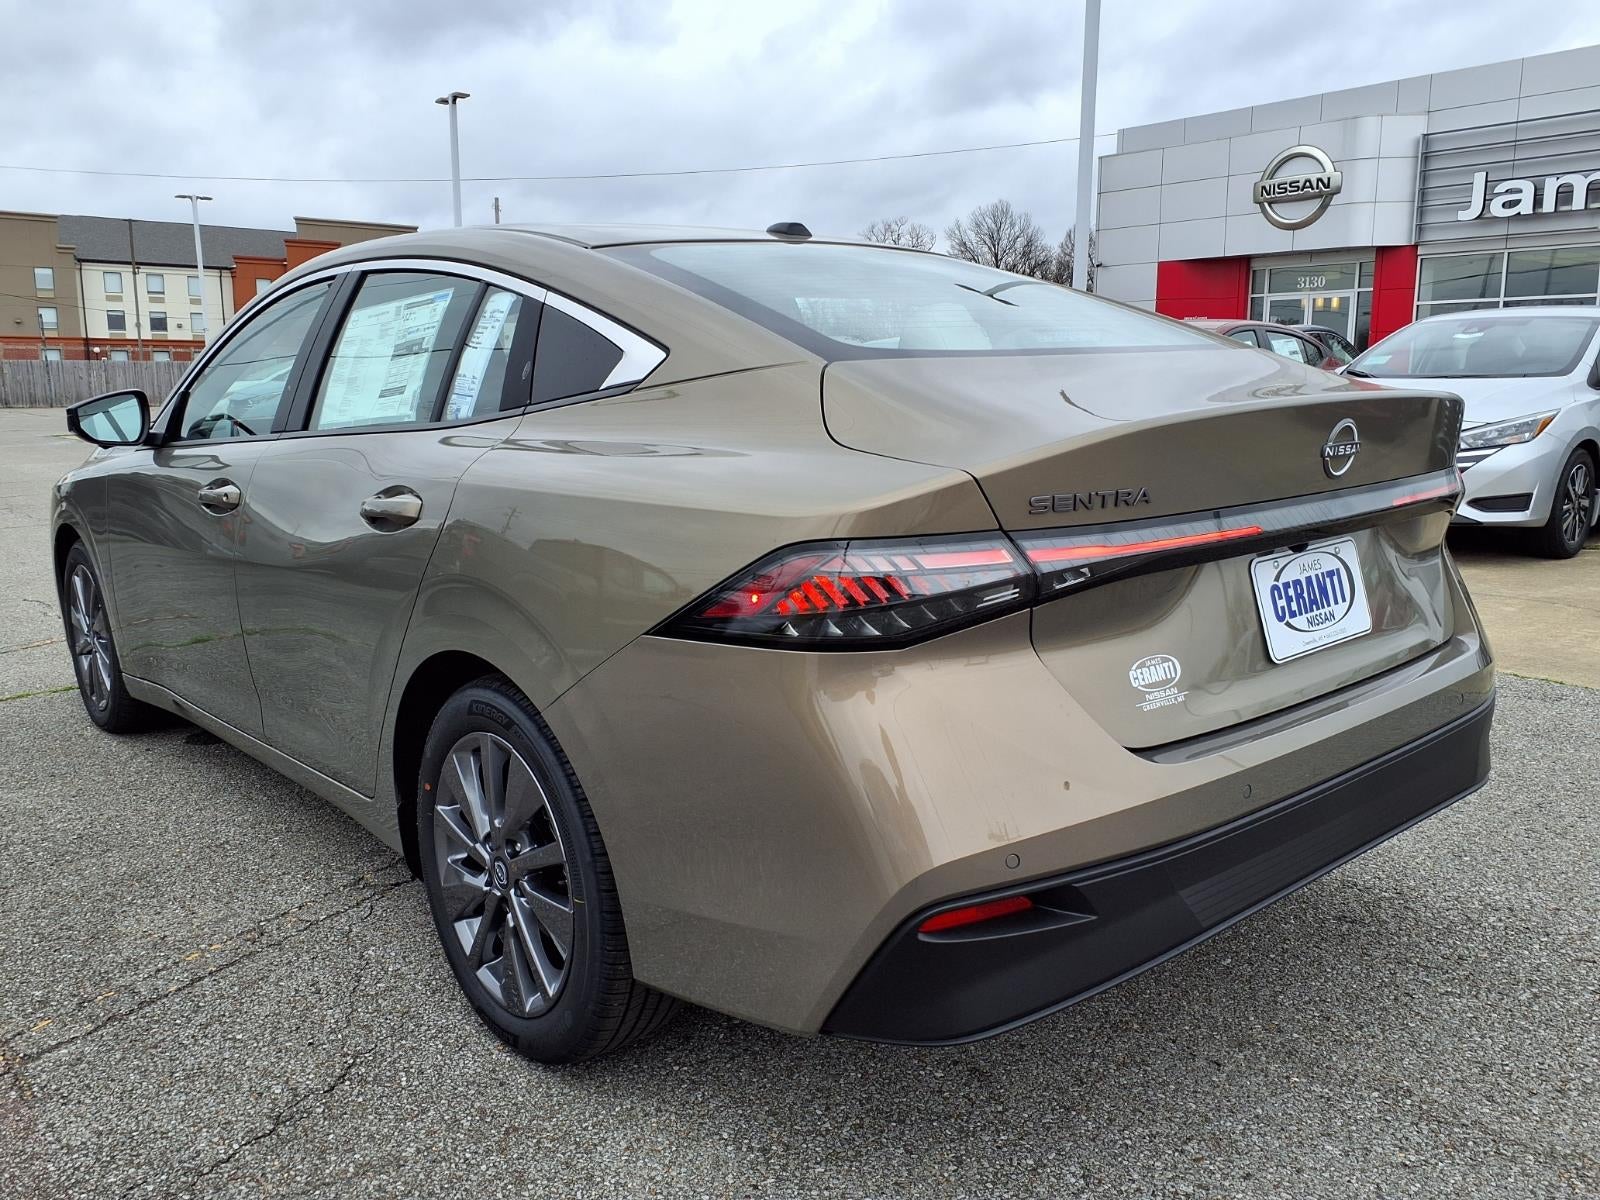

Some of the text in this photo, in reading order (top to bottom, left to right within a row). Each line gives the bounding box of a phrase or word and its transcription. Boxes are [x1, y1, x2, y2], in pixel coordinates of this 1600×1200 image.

[1260, 176, 1331, 198] NISSAN
[1297, 275, 1326, 289] 3130
[1325, 443, 1360, 457] NISSAN
[1029, 487, 1151, 515] SENTRA
[1299, 558, 1322, 575] JAMES
[1270, 567, 1347, 623] CERANTI
[1305, 608, 1336, 629] NISSAN
[1145, 657, 1162, 667] JAMES
[1129, 661, 1176, 688] CERANTI
[1145, 687, 1178, 701] NISSAN
